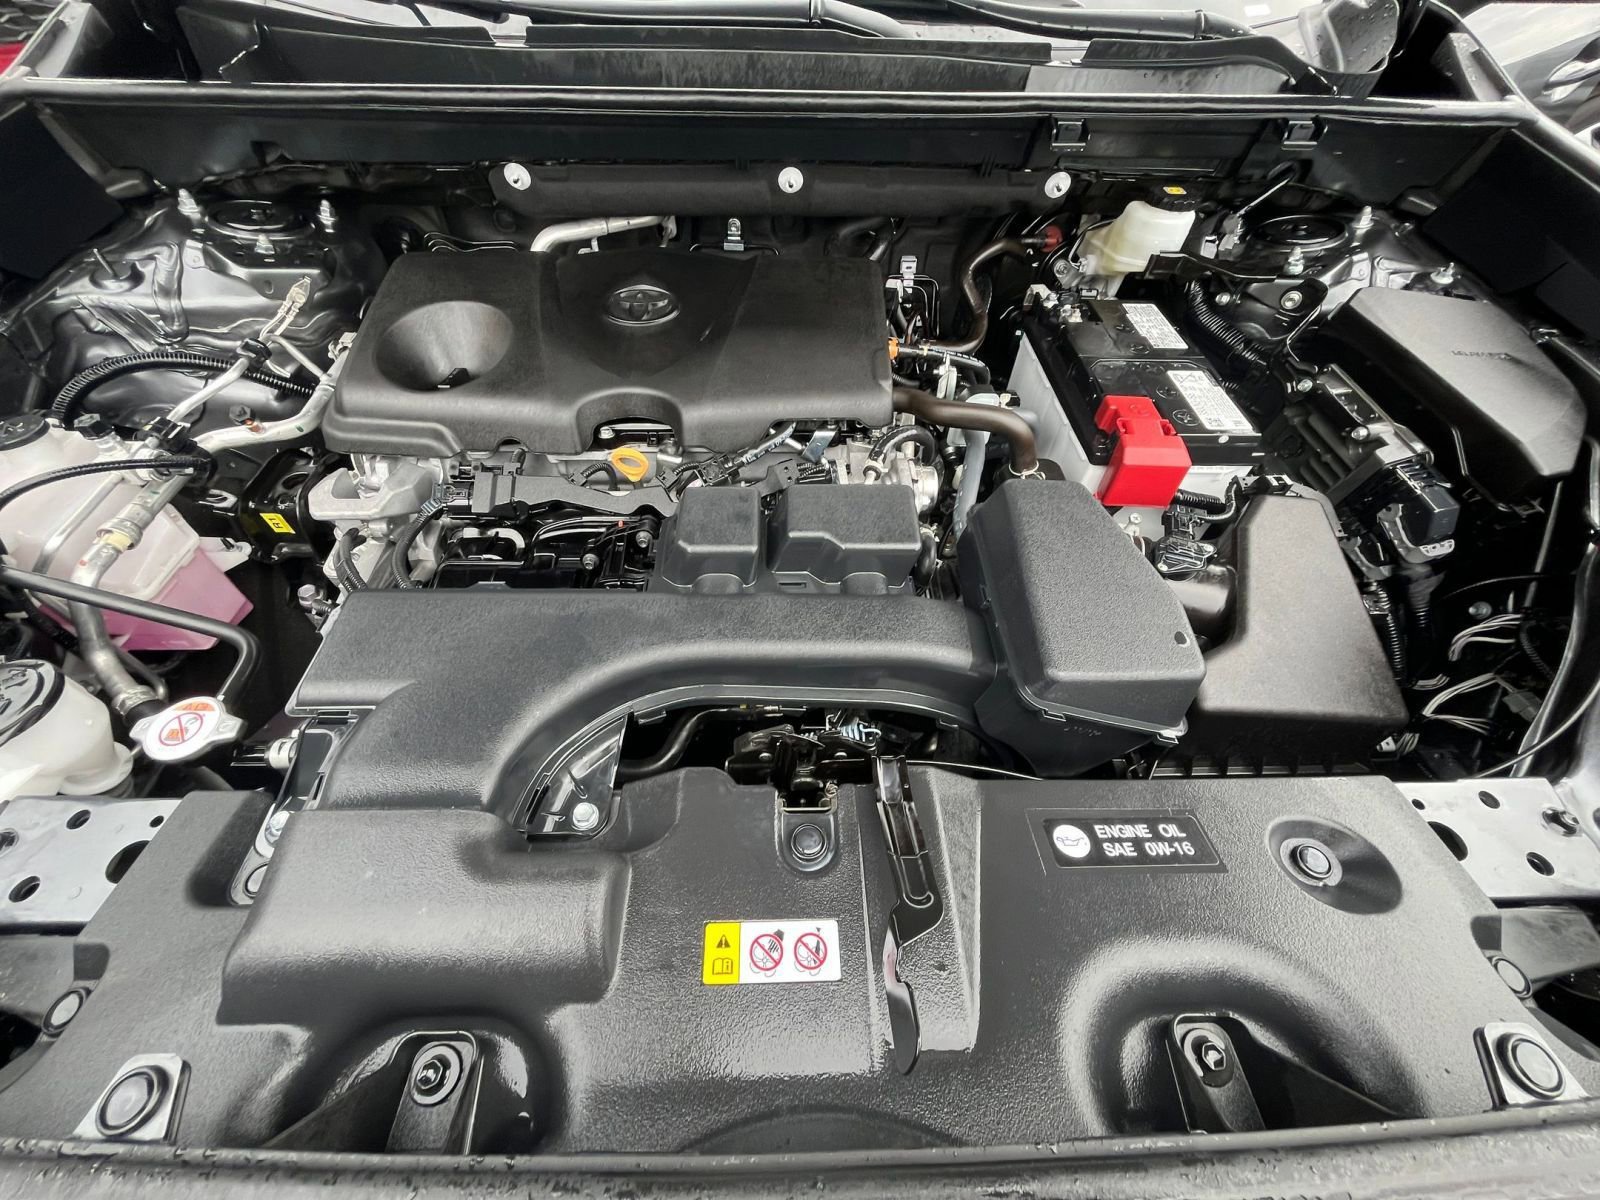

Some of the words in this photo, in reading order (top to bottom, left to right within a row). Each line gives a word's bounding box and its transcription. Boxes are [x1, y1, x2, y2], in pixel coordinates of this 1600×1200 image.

[1093, 824, 1153, 838] ENGINE
[1158, 823, 1187, 838] OIL
[1102, 841, 1138, 857] SAE
[1144, 841, 1196, 856] 0W-16
